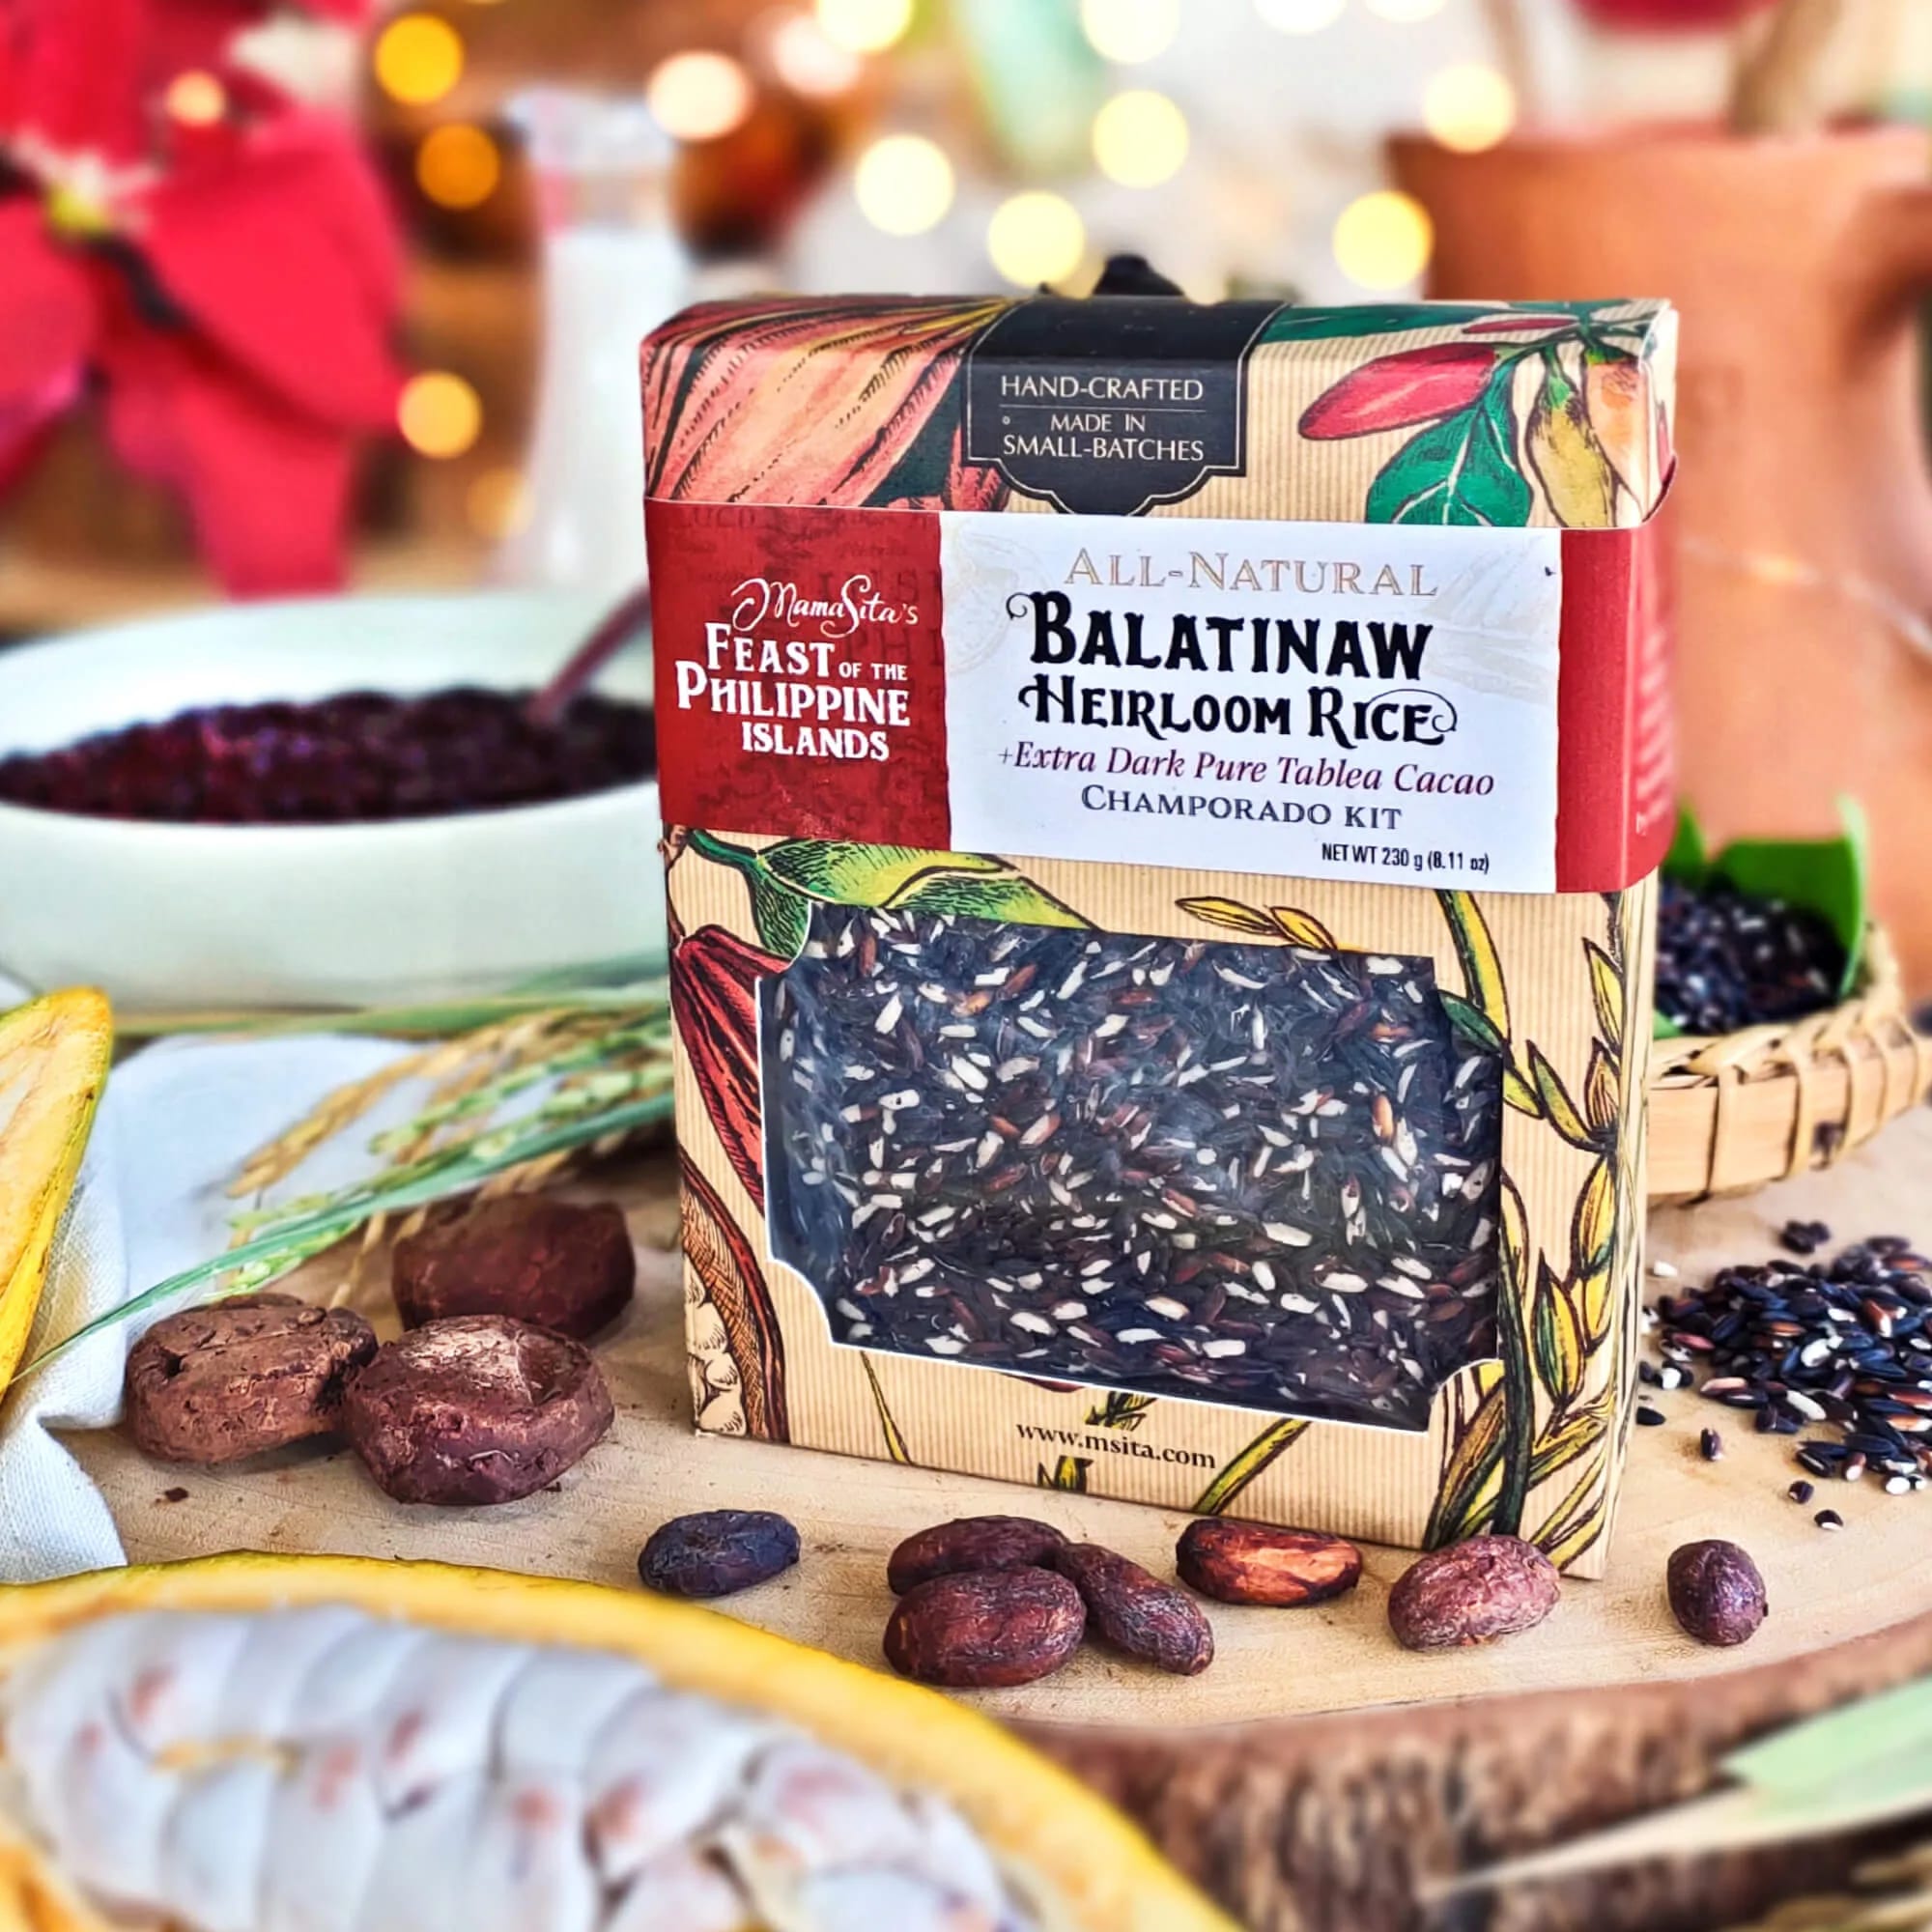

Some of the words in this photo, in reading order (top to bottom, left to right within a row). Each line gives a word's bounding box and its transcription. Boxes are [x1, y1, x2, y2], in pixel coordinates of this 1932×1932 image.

[1001, 375, 1204, 401] HAND-CRAFTED
[1050, 414, 1112, 433] MADE
[1124, 414, 1146, 433] IN
[1003, 436, 1205, 461] SMALL-BATCHES
[704, 621, 836, 678] FEAST
[838, 662, 863, 678] OF
[870, 664, 908, 681] THE
[1005, 590, 1434, 681] BALATINAW
[674, 660, 911, 726] PHILIPPINE
[1017, 673, 1292, 741] HEIRLOOM
[1307, 686, 1458, 750] RICE
[741, 721, 890, 762] ISLANDS
[1106, 746, 1185, 778] Dark
[1194, 751, 1267, 782] Pure
[1277, 755, 1383, 790] Tablea
[1394, 763, 1494, 796] Cacao
[1081, 783, 1332, 826] CHAMPORADO
[1344, 805, 1402, 830] KIT
[1321, 842, 1350, 863] NET
[1352, 845, 1377, 865] WT
[1381, 847, 1409, 867] 230
[1413, 853, 1424, 871] g
[1427, 850, 1464, 870] (8.11
[1469, 852, 1490, 874] oz)
[1015, 1423, 1216, 1469] www.msita.com
